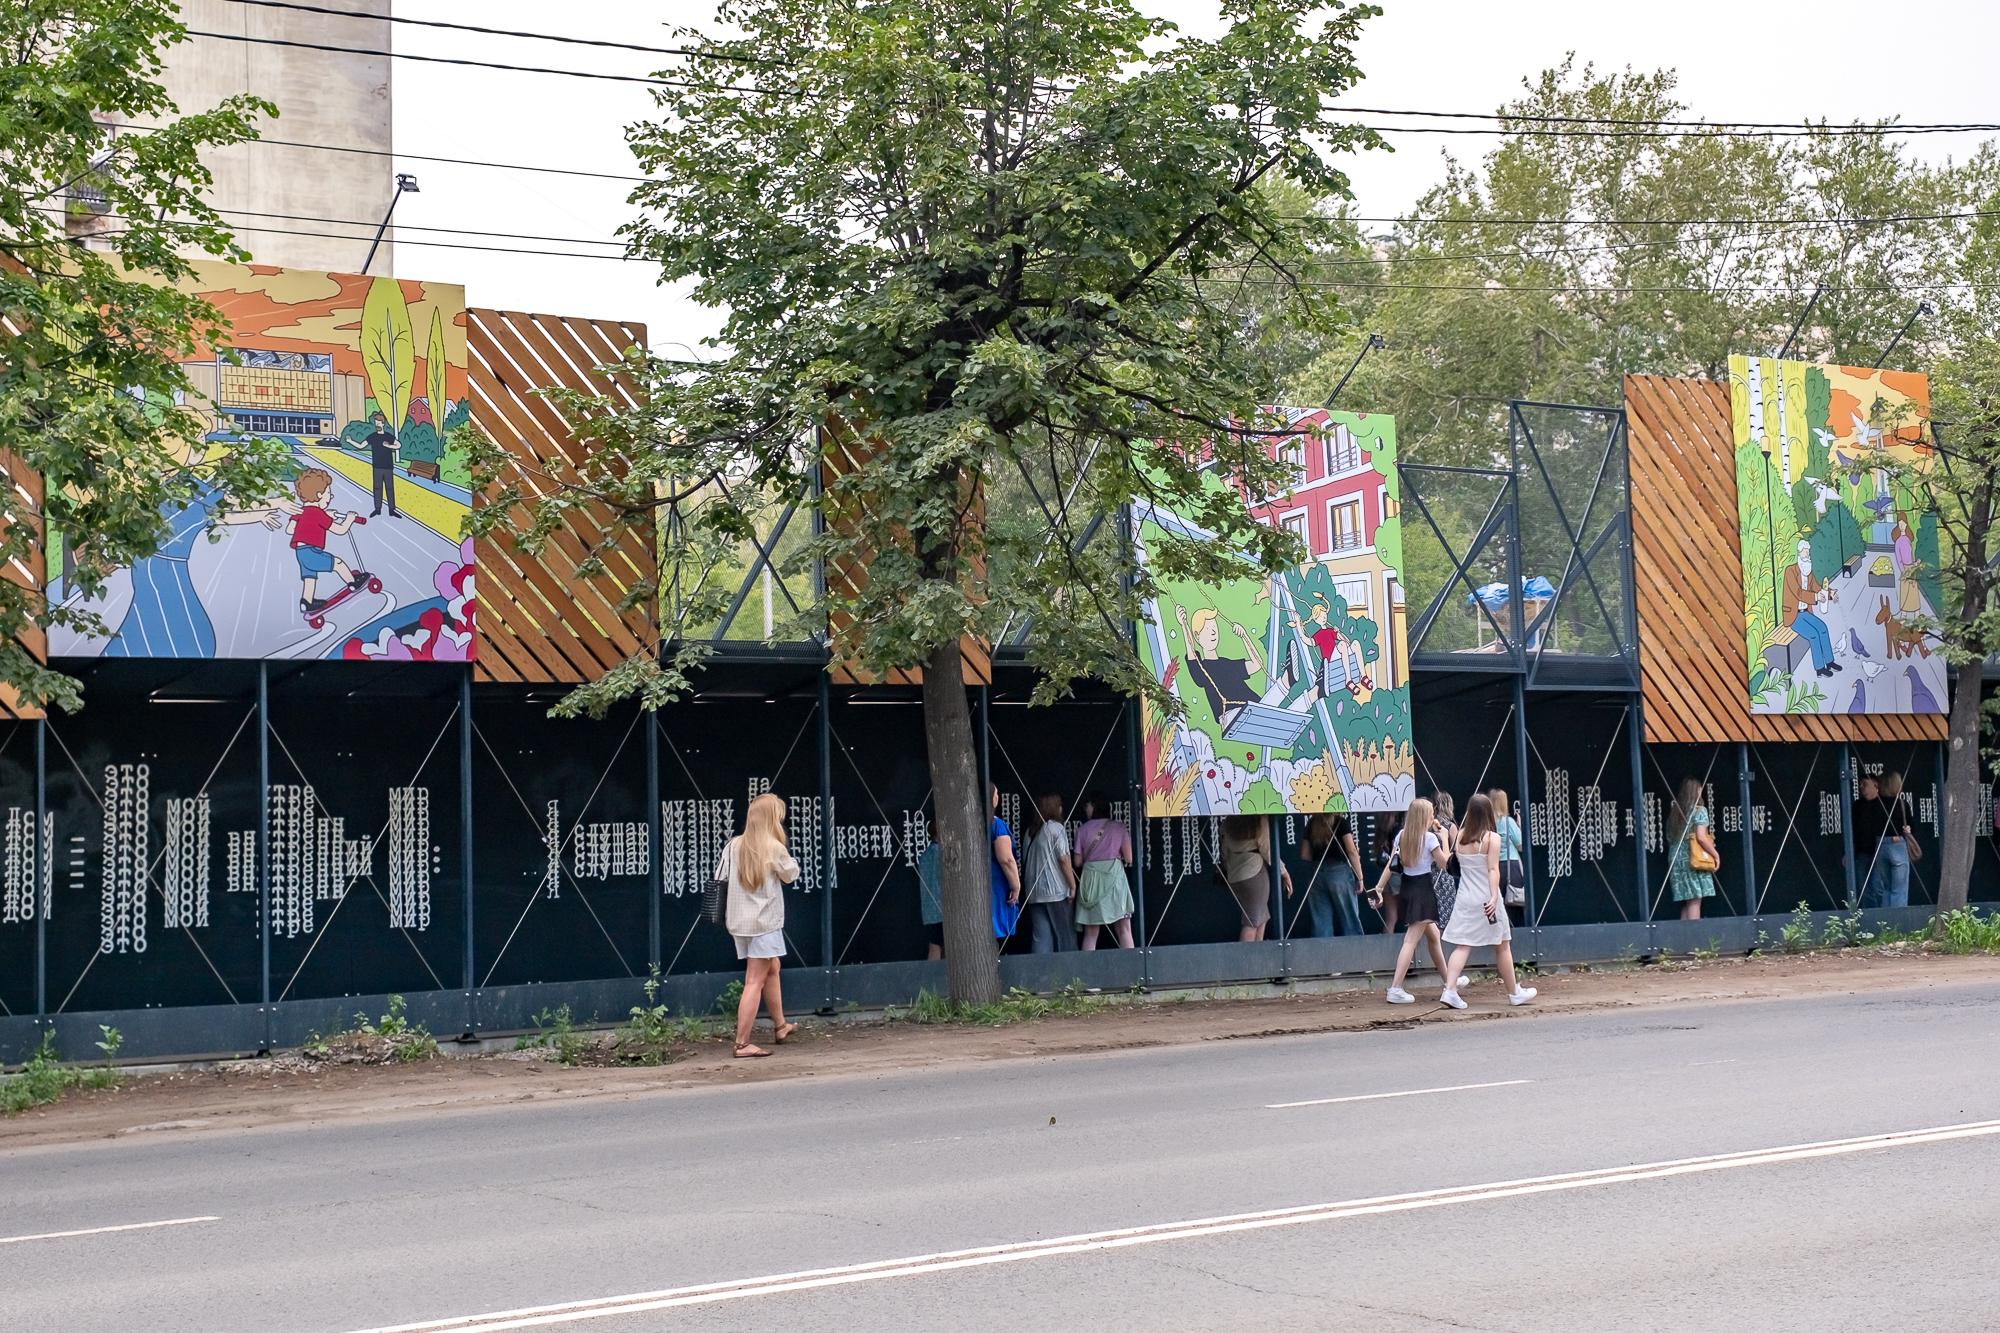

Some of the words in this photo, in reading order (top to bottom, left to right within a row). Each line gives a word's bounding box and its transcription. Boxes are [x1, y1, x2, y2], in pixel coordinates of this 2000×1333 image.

[164, 791, 210, 928] мой
[573, 822, 650, 881] слушаю
[662, 799, 735, 898] музыку
